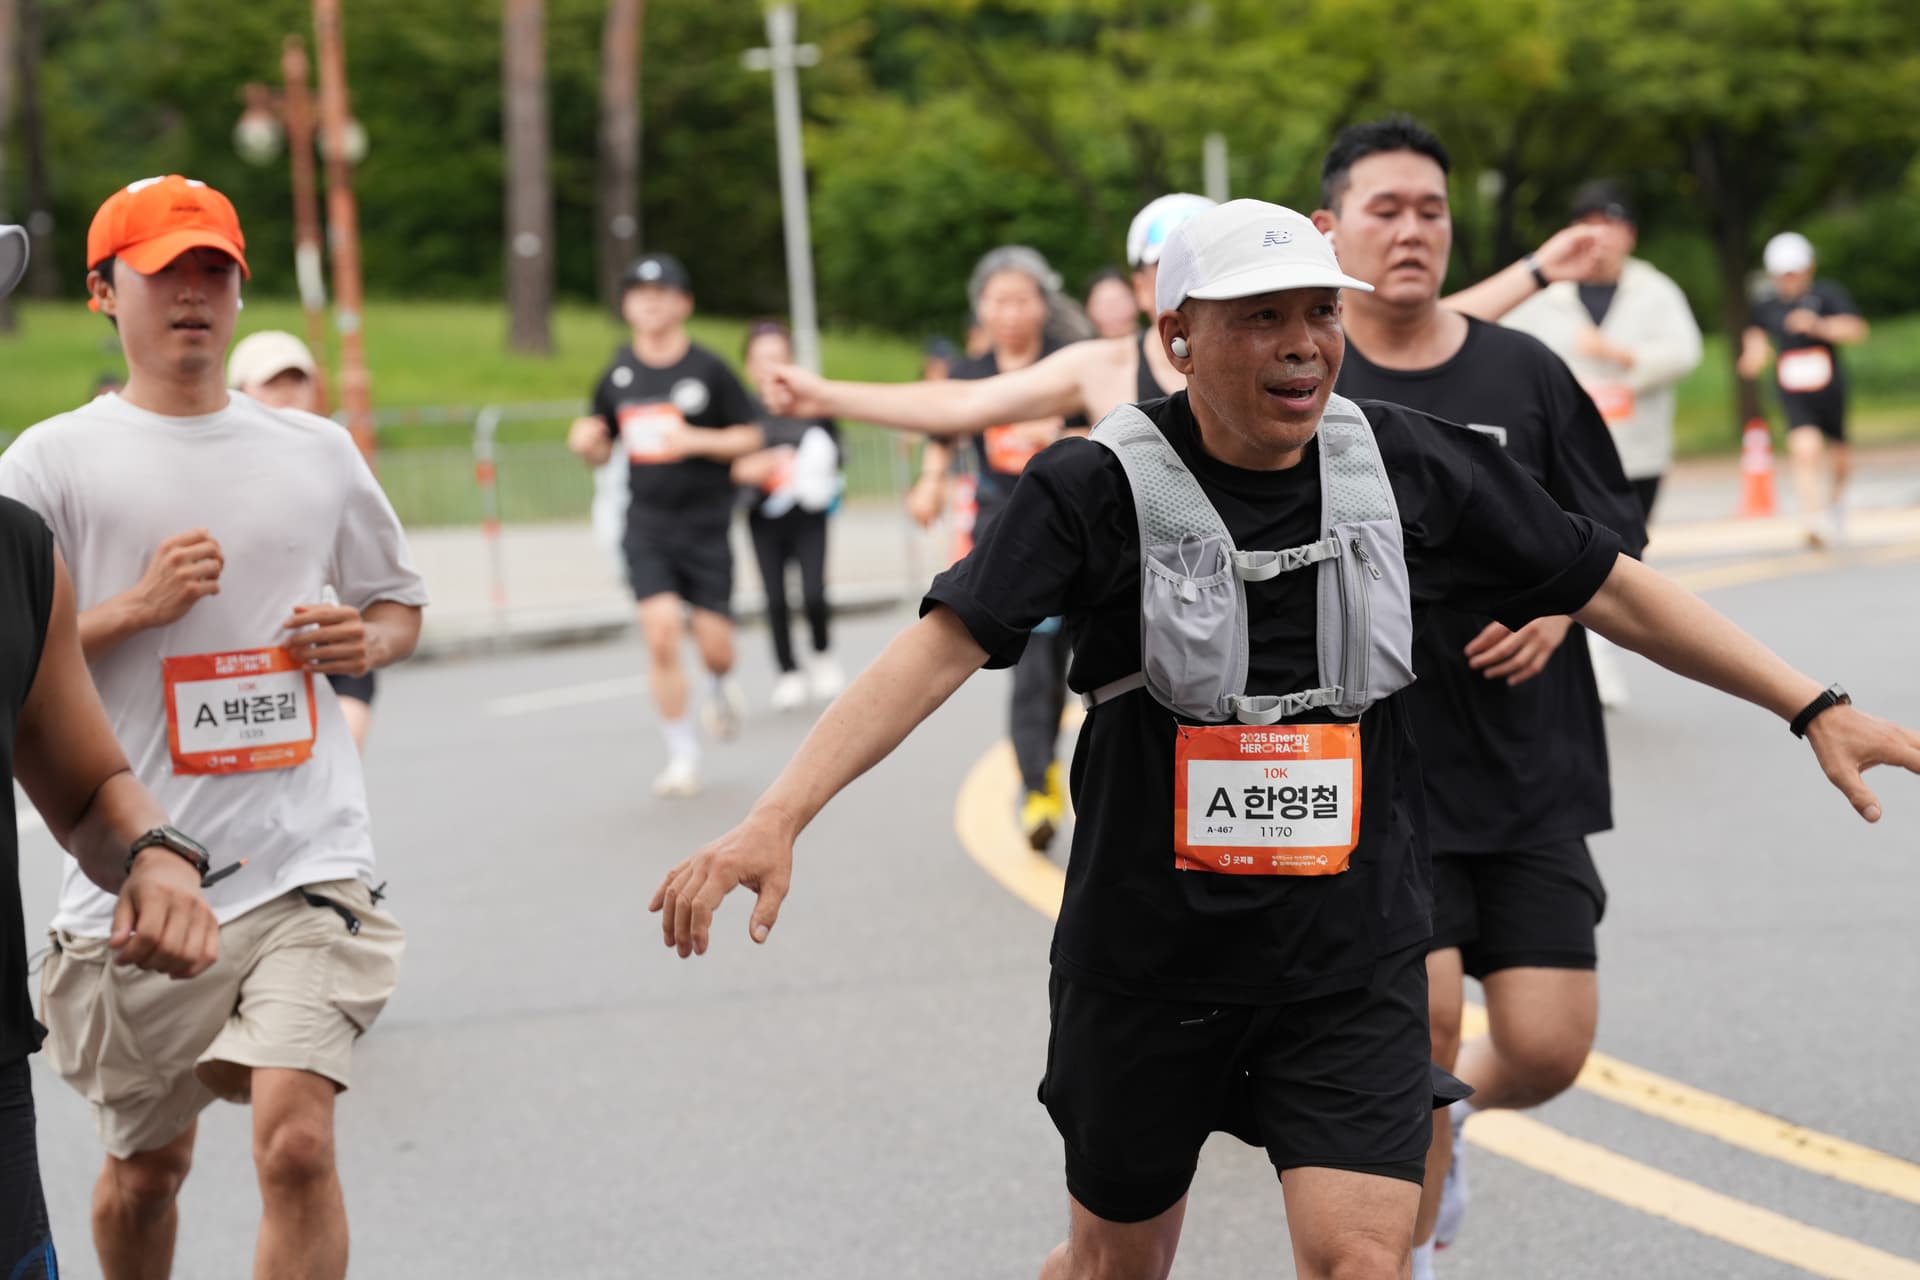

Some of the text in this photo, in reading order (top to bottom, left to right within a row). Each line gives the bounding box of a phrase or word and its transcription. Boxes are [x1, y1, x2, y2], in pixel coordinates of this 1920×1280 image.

[194, 692, 297, 728] A 박준길
[1240, 732, 1310, 746] 2025 Energy
[1263, 767, 1288, 778] 10K
[1206, 785, 1338, 820] A 한영철
[1207, 826, 1233, 834] A-467
[1260, 826, 1293, 838] 1170
